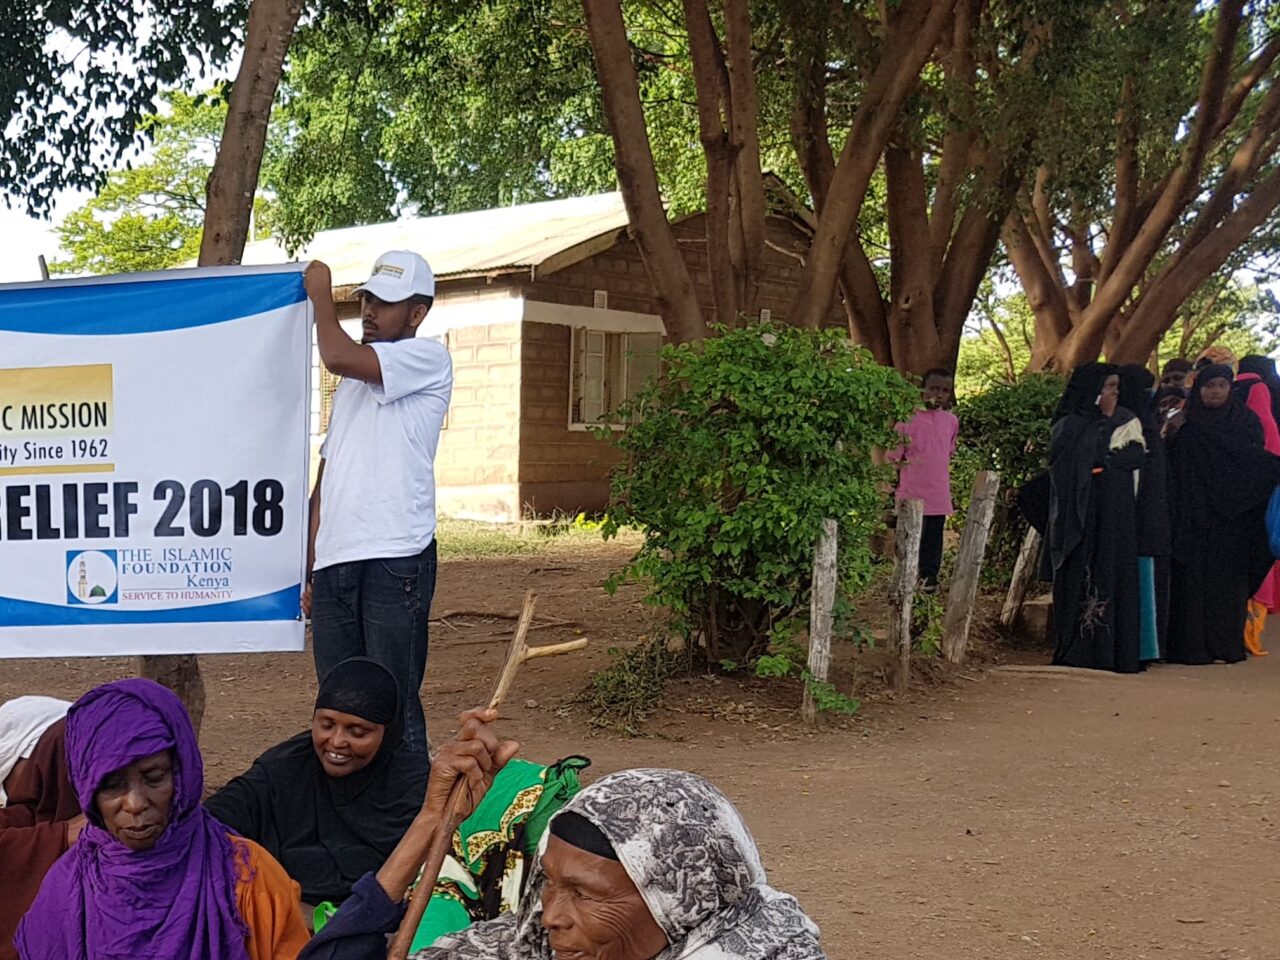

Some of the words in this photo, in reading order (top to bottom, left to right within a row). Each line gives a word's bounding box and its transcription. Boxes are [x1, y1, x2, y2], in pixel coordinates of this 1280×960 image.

[21, 401, 108, 430] MISSION
[24, 442, 64, 460] Since
[71, 439, 108, 458] 1962
[152, 479, 285, 537] 2018
[120, 549, 152, 562] THE
[163, 547, 232, 562] ISLAMIC
[122, 561, 232, 575] FOUNDATION
[187, 575, 229, 590] Kenya
[122, 592, 163, 601] SERVICE
[165, 592, 179, 600] TO
[182, 590, 233, 600] HUMANITY
